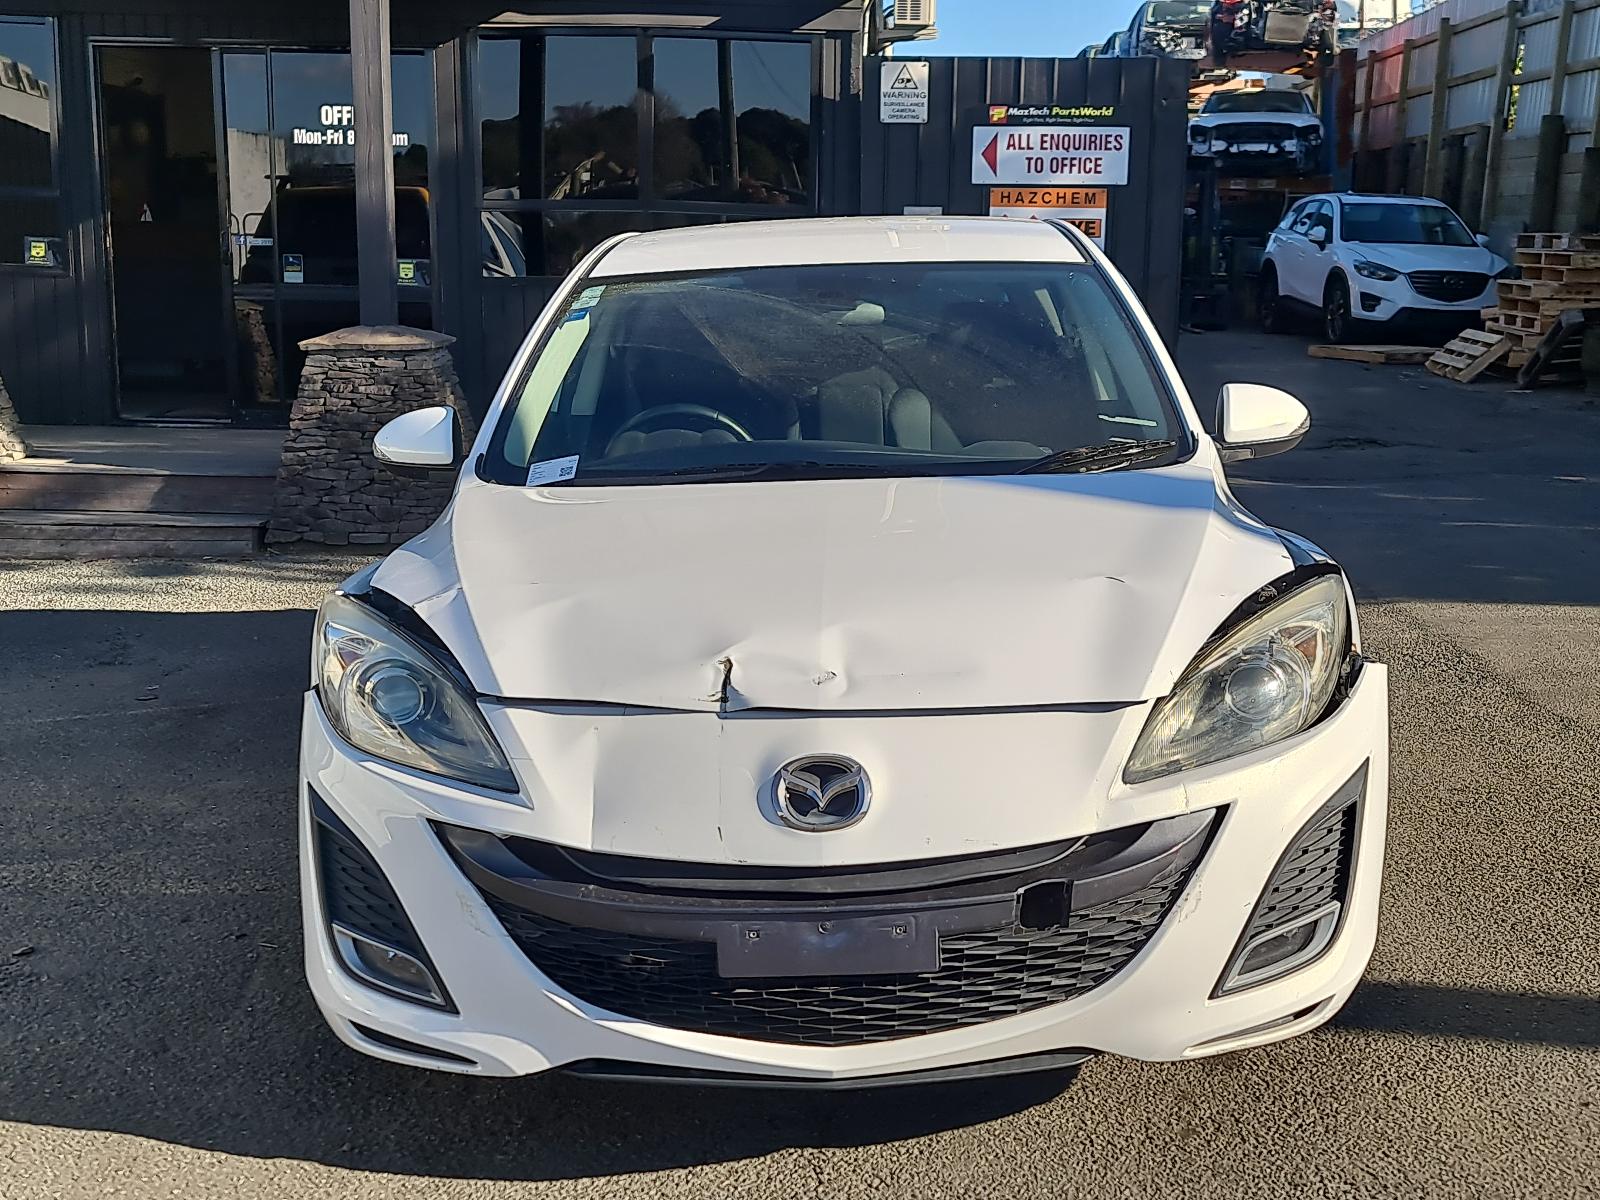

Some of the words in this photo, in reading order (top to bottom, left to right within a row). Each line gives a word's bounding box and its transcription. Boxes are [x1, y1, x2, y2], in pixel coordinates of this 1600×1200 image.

[883, 91, 927, 99] WARNING
[321, 105, 354, 126] OFF
[294, 129, 343, 145] Mon-Fri
[347, 130, 355, 145] 8
[1006, 134, 1034, 151] ALL
[1040, 134, 1123, 152] ENQUIRIES
[1025, 157, 1044, 173] TO
[1049, 157, 1103, 174] OFFICE
[1000, 191, 1096, 205] HAZCHEM
